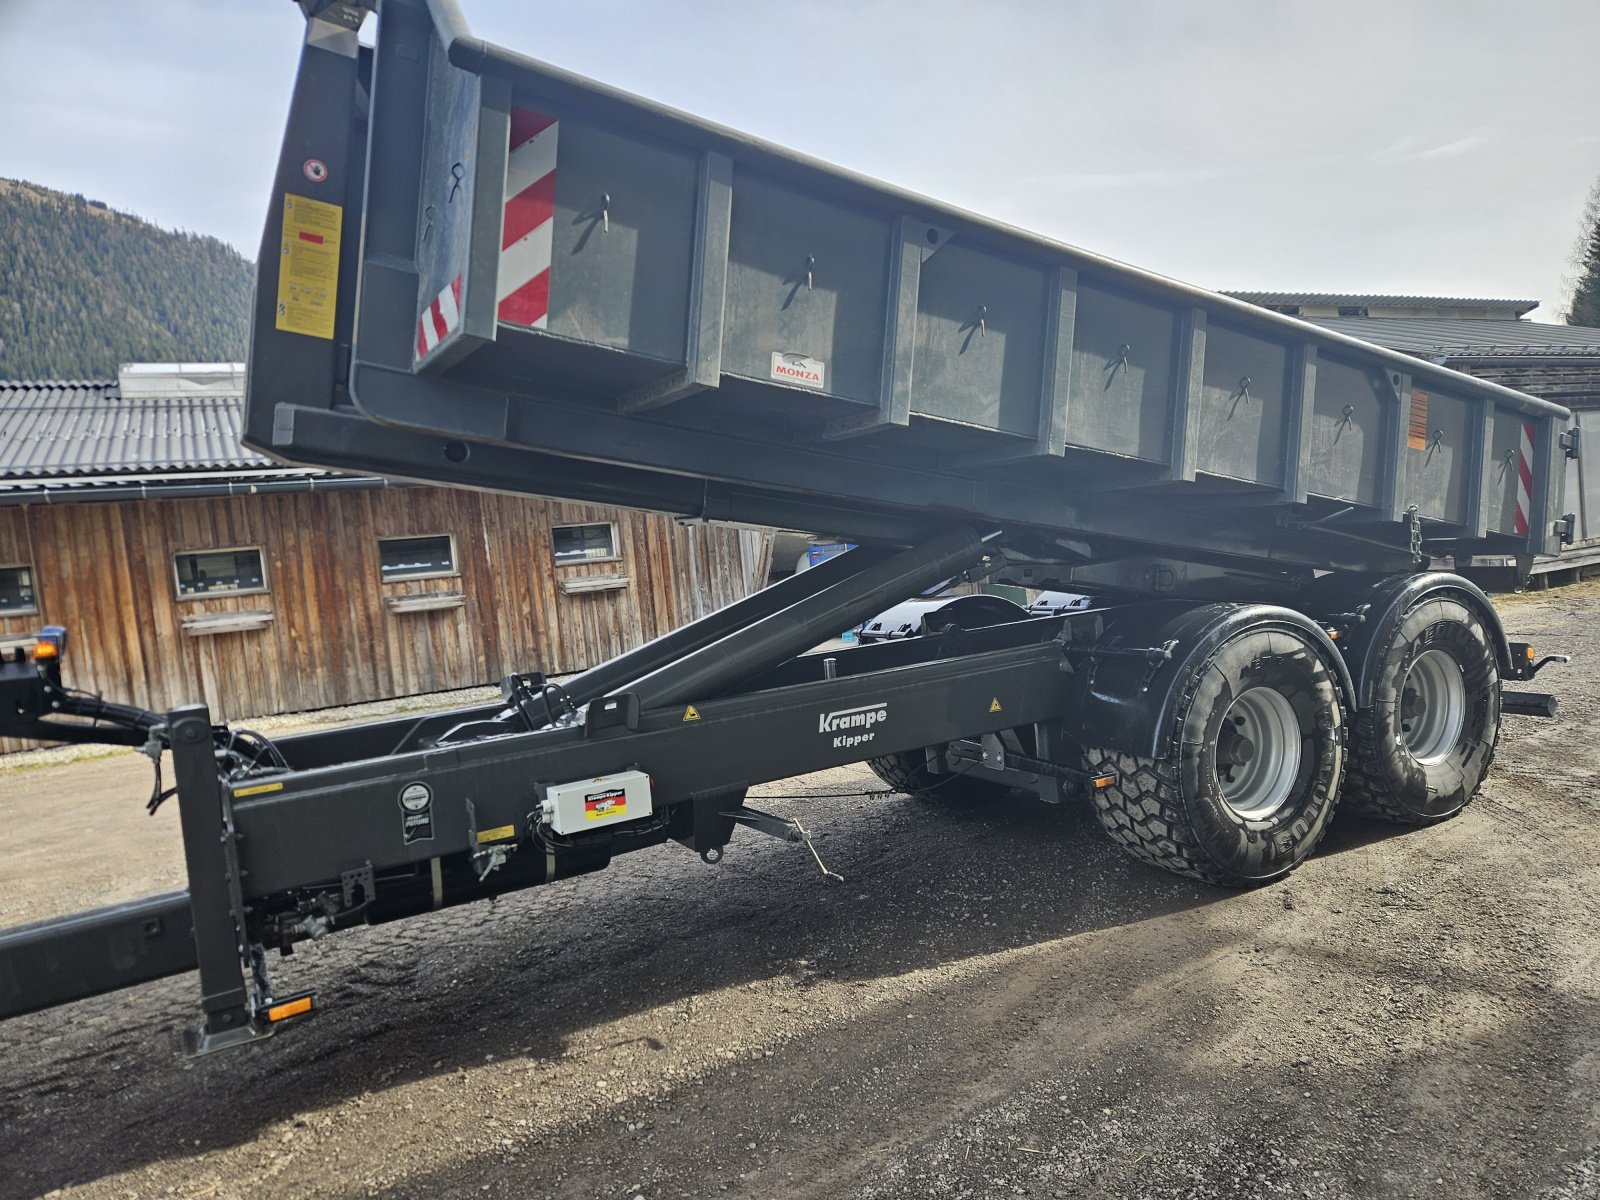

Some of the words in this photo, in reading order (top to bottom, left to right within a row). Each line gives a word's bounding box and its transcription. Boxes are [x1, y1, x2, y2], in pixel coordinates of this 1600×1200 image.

[776, 366, 819, 381] MONZA
[819, 702, 888, 733] Krampe
[833, 732, 875, 748] Kipper
